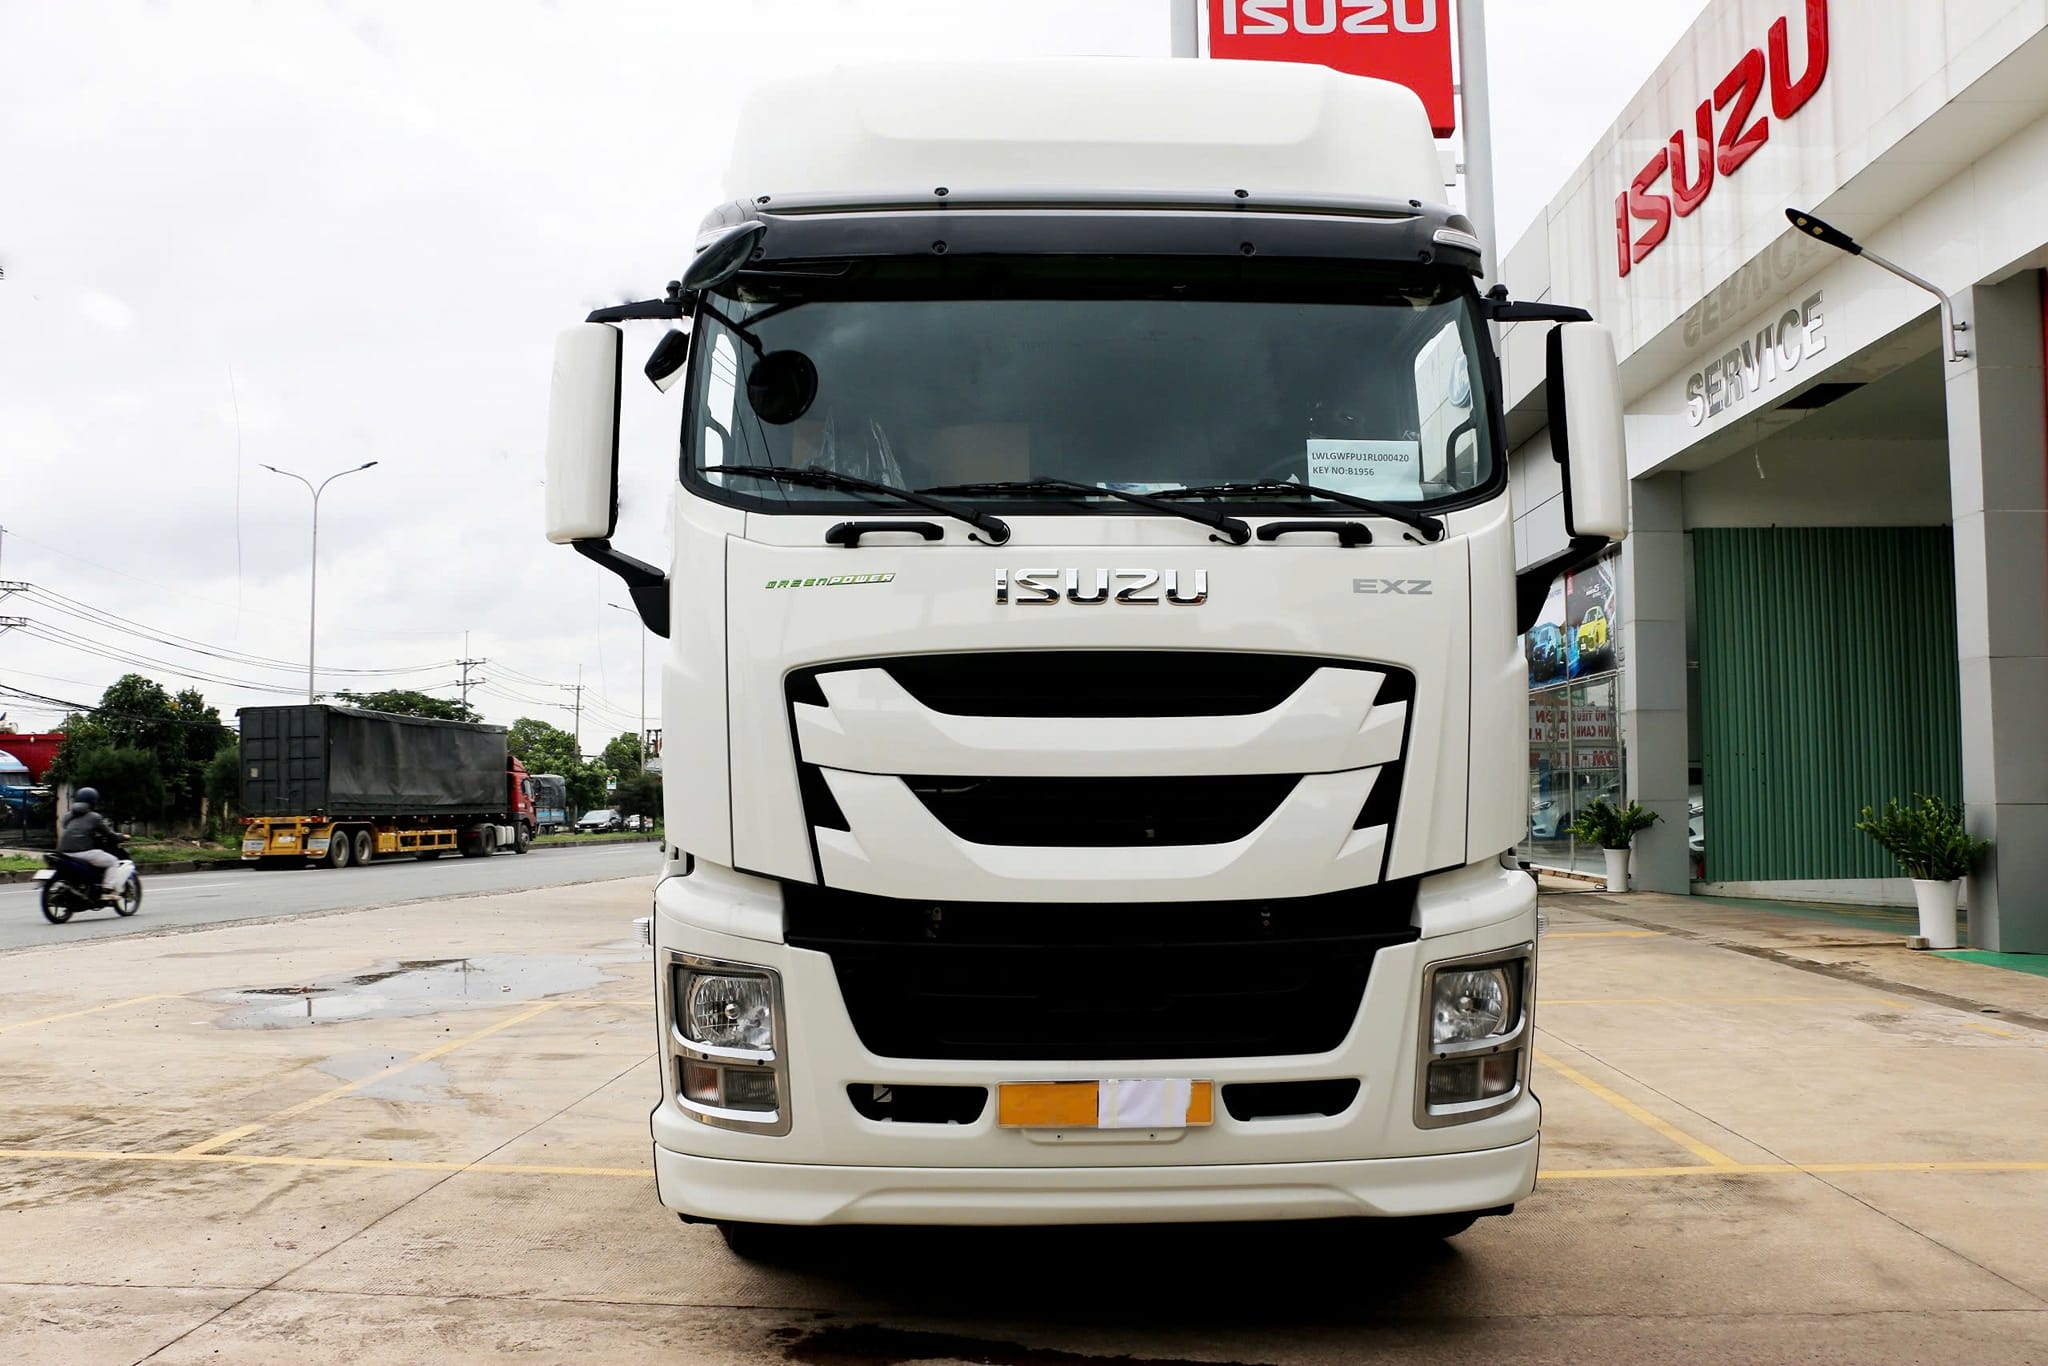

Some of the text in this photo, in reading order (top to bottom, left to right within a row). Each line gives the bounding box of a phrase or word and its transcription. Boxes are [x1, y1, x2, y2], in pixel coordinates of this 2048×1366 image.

[1223, 0, 1437, 34] ISUZU
[1615, 0, 1828, 277] ISUZU
[1685, 290, 1827, 427] SERVICE
[1311, 452, 1409, 462] LWLGWFPU1RL000420
[1312, 466, 1329, 474] KEY
[995, 568, 1208, 605] ISUZU
[1353, 579, 1432, 594] EXZ
